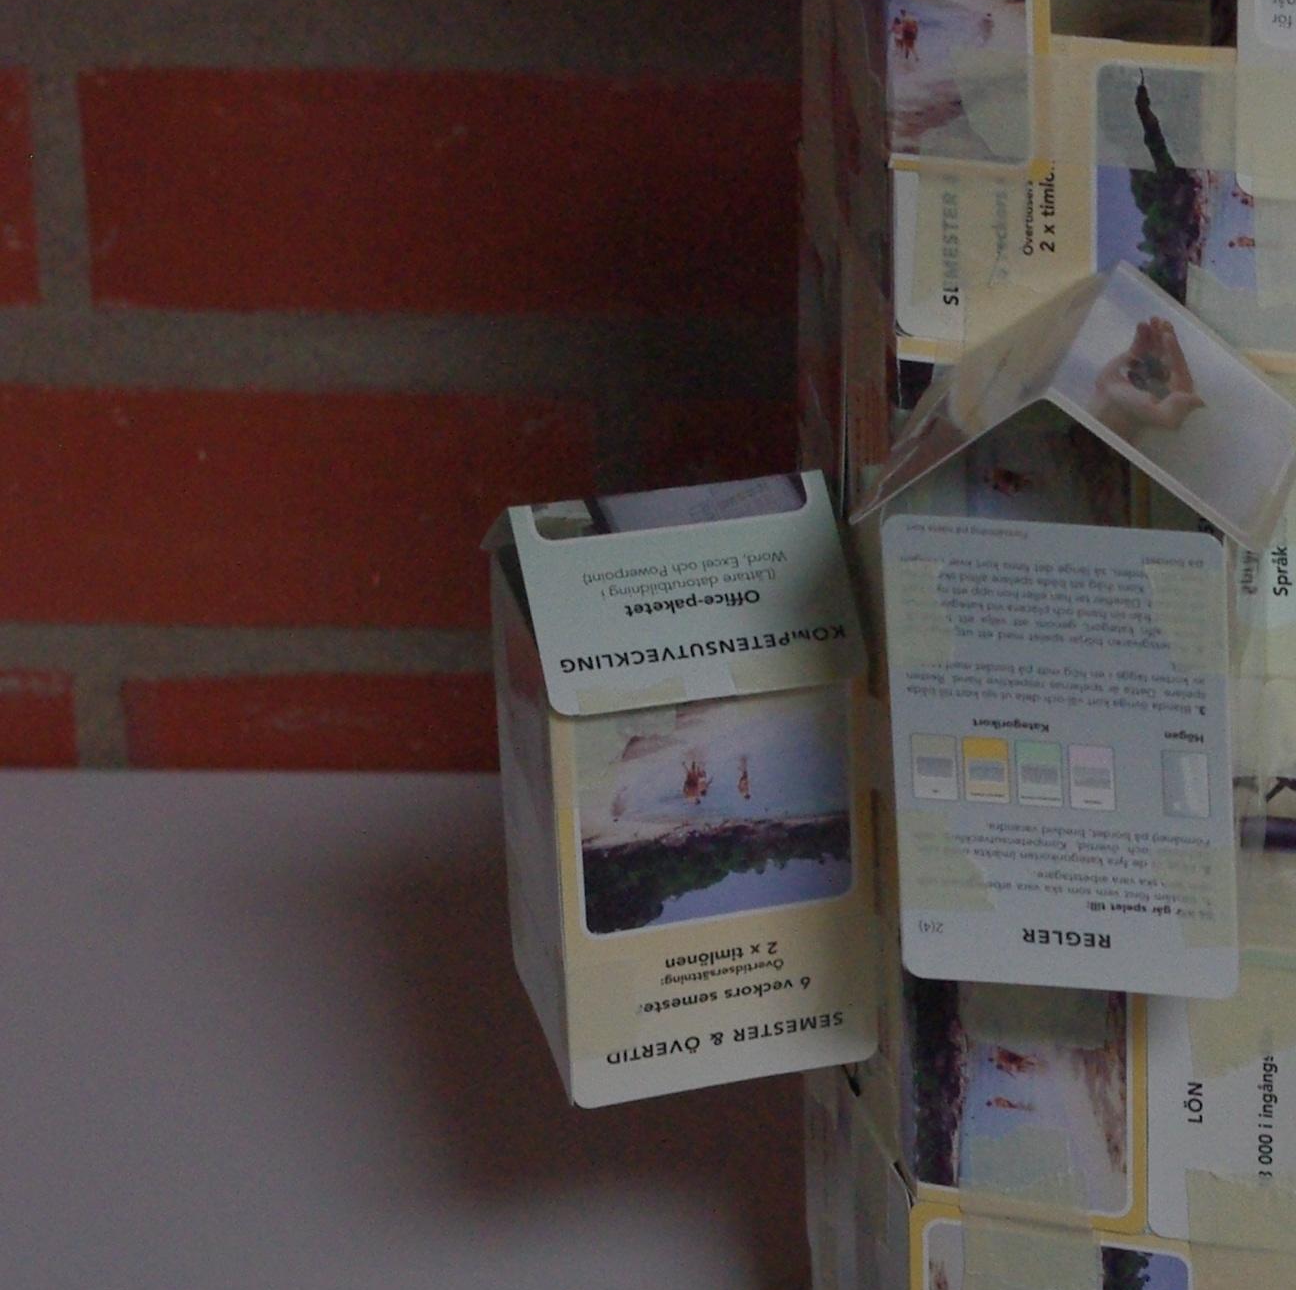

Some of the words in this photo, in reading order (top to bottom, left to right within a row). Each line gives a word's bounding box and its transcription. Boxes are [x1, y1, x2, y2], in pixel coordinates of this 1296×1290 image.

[1040, 241, 1056, 253] 2
[623, 589, 761, 617] Office-paketet
[558, 623, 851, 673] KOMPETENSUTVECKLING
[767, 940, 776, 953] 2
[1022, 926, 1112, 950] REGLER
[664, 946, 742, 969] timlönen
[659, 958, 783, 986] Övertidsersättning:
[800, 976, 810, 989] 6
[724, 978, 792, 999] veckors
[710, 1031, 723, 1045] &
[733, 1011, 842, 1042] SEMESTER
[605, 1036, 700, 1064] ÖVERTID
[1184, 1081, 1204, 1124] LÖN
[1257, 1134, 1273, 1165] 000
